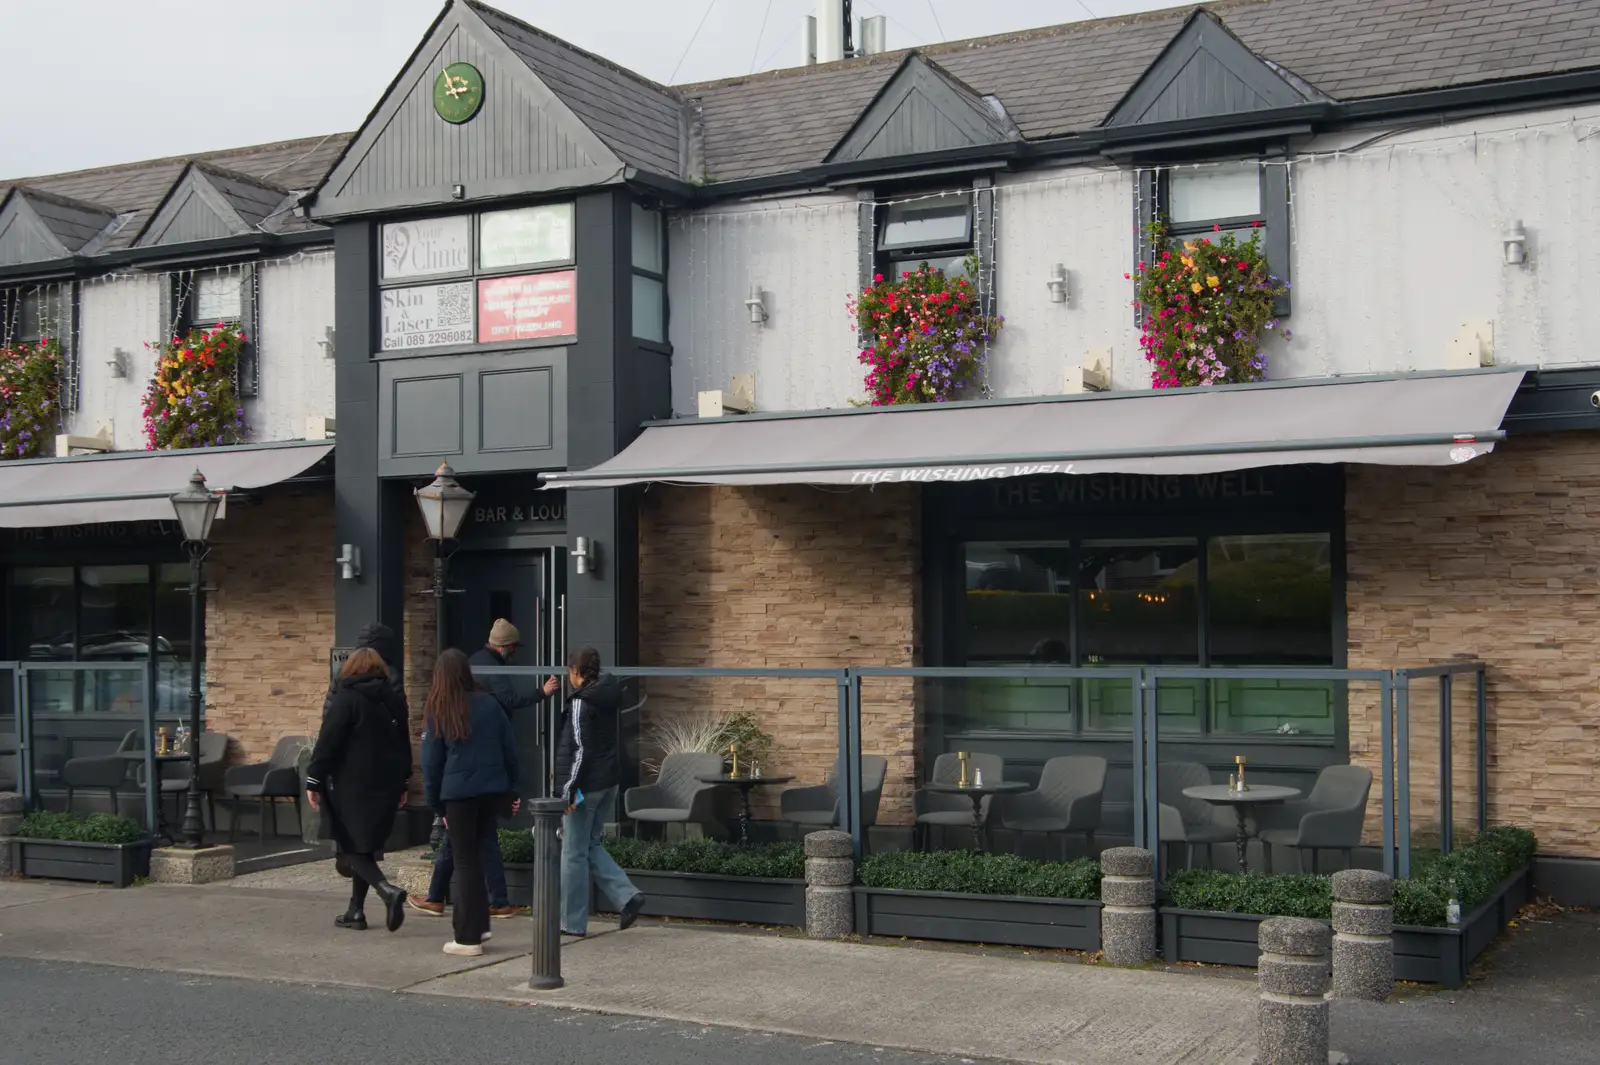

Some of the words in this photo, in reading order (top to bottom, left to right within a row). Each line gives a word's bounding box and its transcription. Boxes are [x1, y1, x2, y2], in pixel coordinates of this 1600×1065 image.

[412, 237, 466, 270] Clinic
[384, 288, 423, 309] Skin
[384, 316, 433, 333] Laser
[384, 336, 403, 348] Call
[406, 334, 425, 346] 089
[428, 330, 472, 344] 2296082
[850, 470, 894, 483] THE
[899, 466, 1006, 482] WISHING
[1013, 464, 1077, 476] WELL
[990, 479, 1043, 505] THE
[1053, 474, 1181, 503] WISHING
[1193, 471, 1274, 497] WELL
[475, 507, 507, 522] BAR
[512, 506, 524, 520] &
